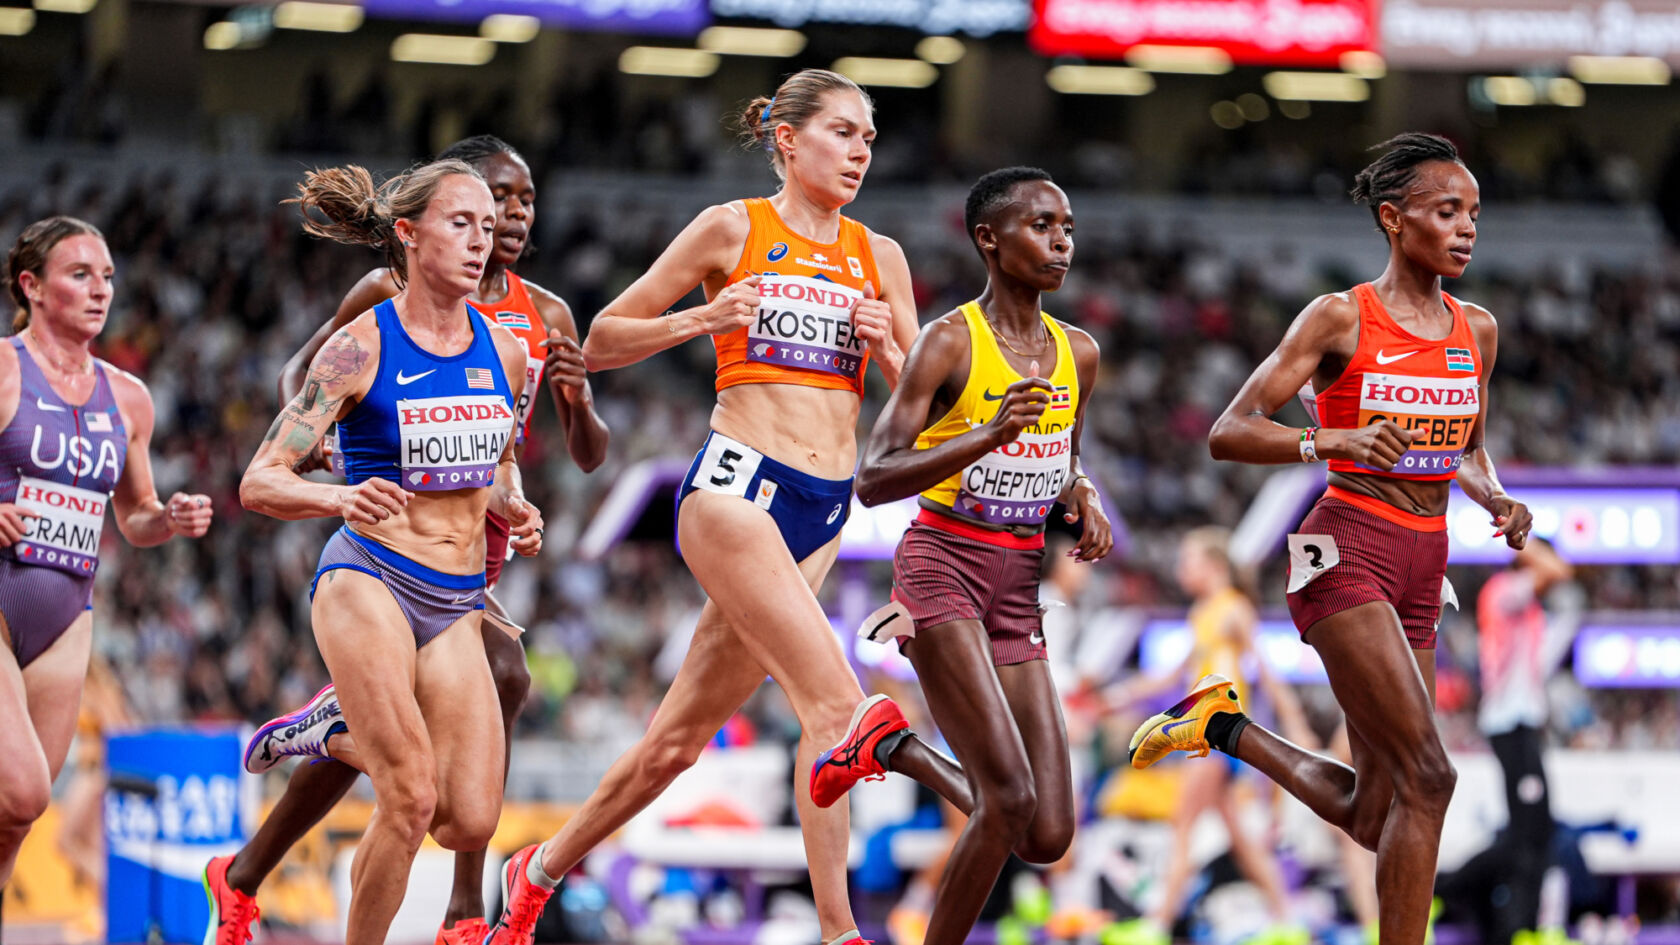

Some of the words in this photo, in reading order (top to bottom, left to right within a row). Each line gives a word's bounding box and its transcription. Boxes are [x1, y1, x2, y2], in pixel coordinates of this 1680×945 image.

[1365, 383, 1478, 406] HONDA
[401, 404, 512, 425] HONDA
[1368, 414, 1473, 446] EBET
[30, 424, 119, 484] USA
[991, 437, 1070, 459] ONDA
[709, 448, 744, 487] 5
[967, 464, 1067, 499] CHEPTOYEK
[20, 485, 104, 517] HOND
[989, 504, 1053, 519] TOKYO
[284, 700, 342, 739] NITRO
